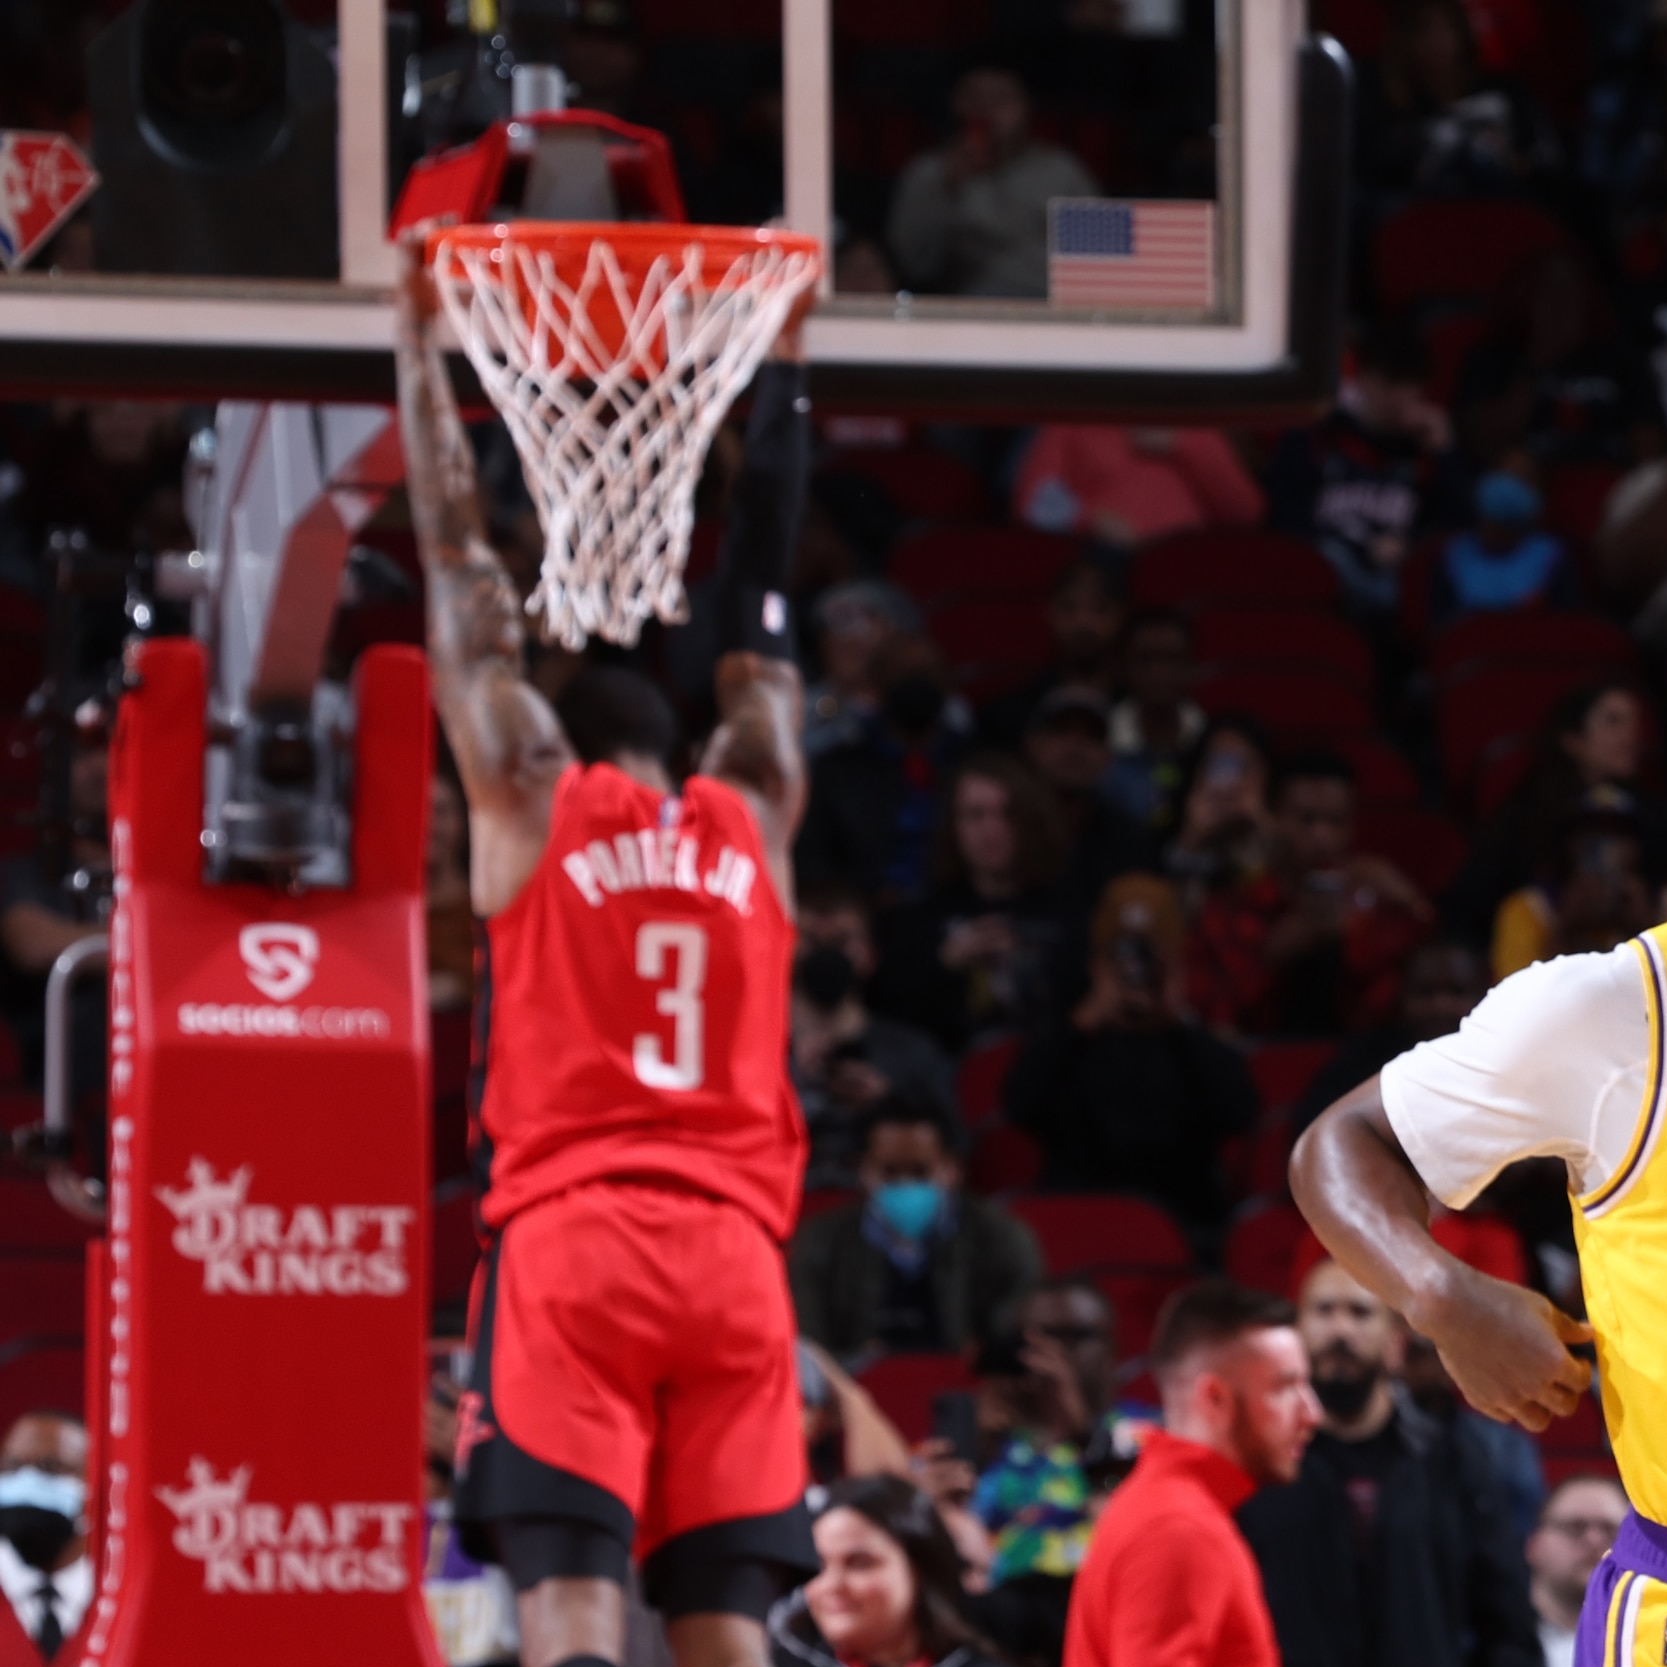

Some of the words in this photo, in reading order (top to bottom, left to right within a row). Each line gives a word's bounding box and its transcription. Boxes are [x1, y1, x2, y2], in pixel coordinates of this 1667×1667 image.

[178, 1003, 390, 1039] socios.com
[632, 920, 708, 1090] 3
[172, 1203, 417, 1261] DRAFT
[203, 1250, 409, 1297] KINGS
[172, 1502, 416, 1560] DRAFT
[204, 1550, 408, 1595] KINGS
